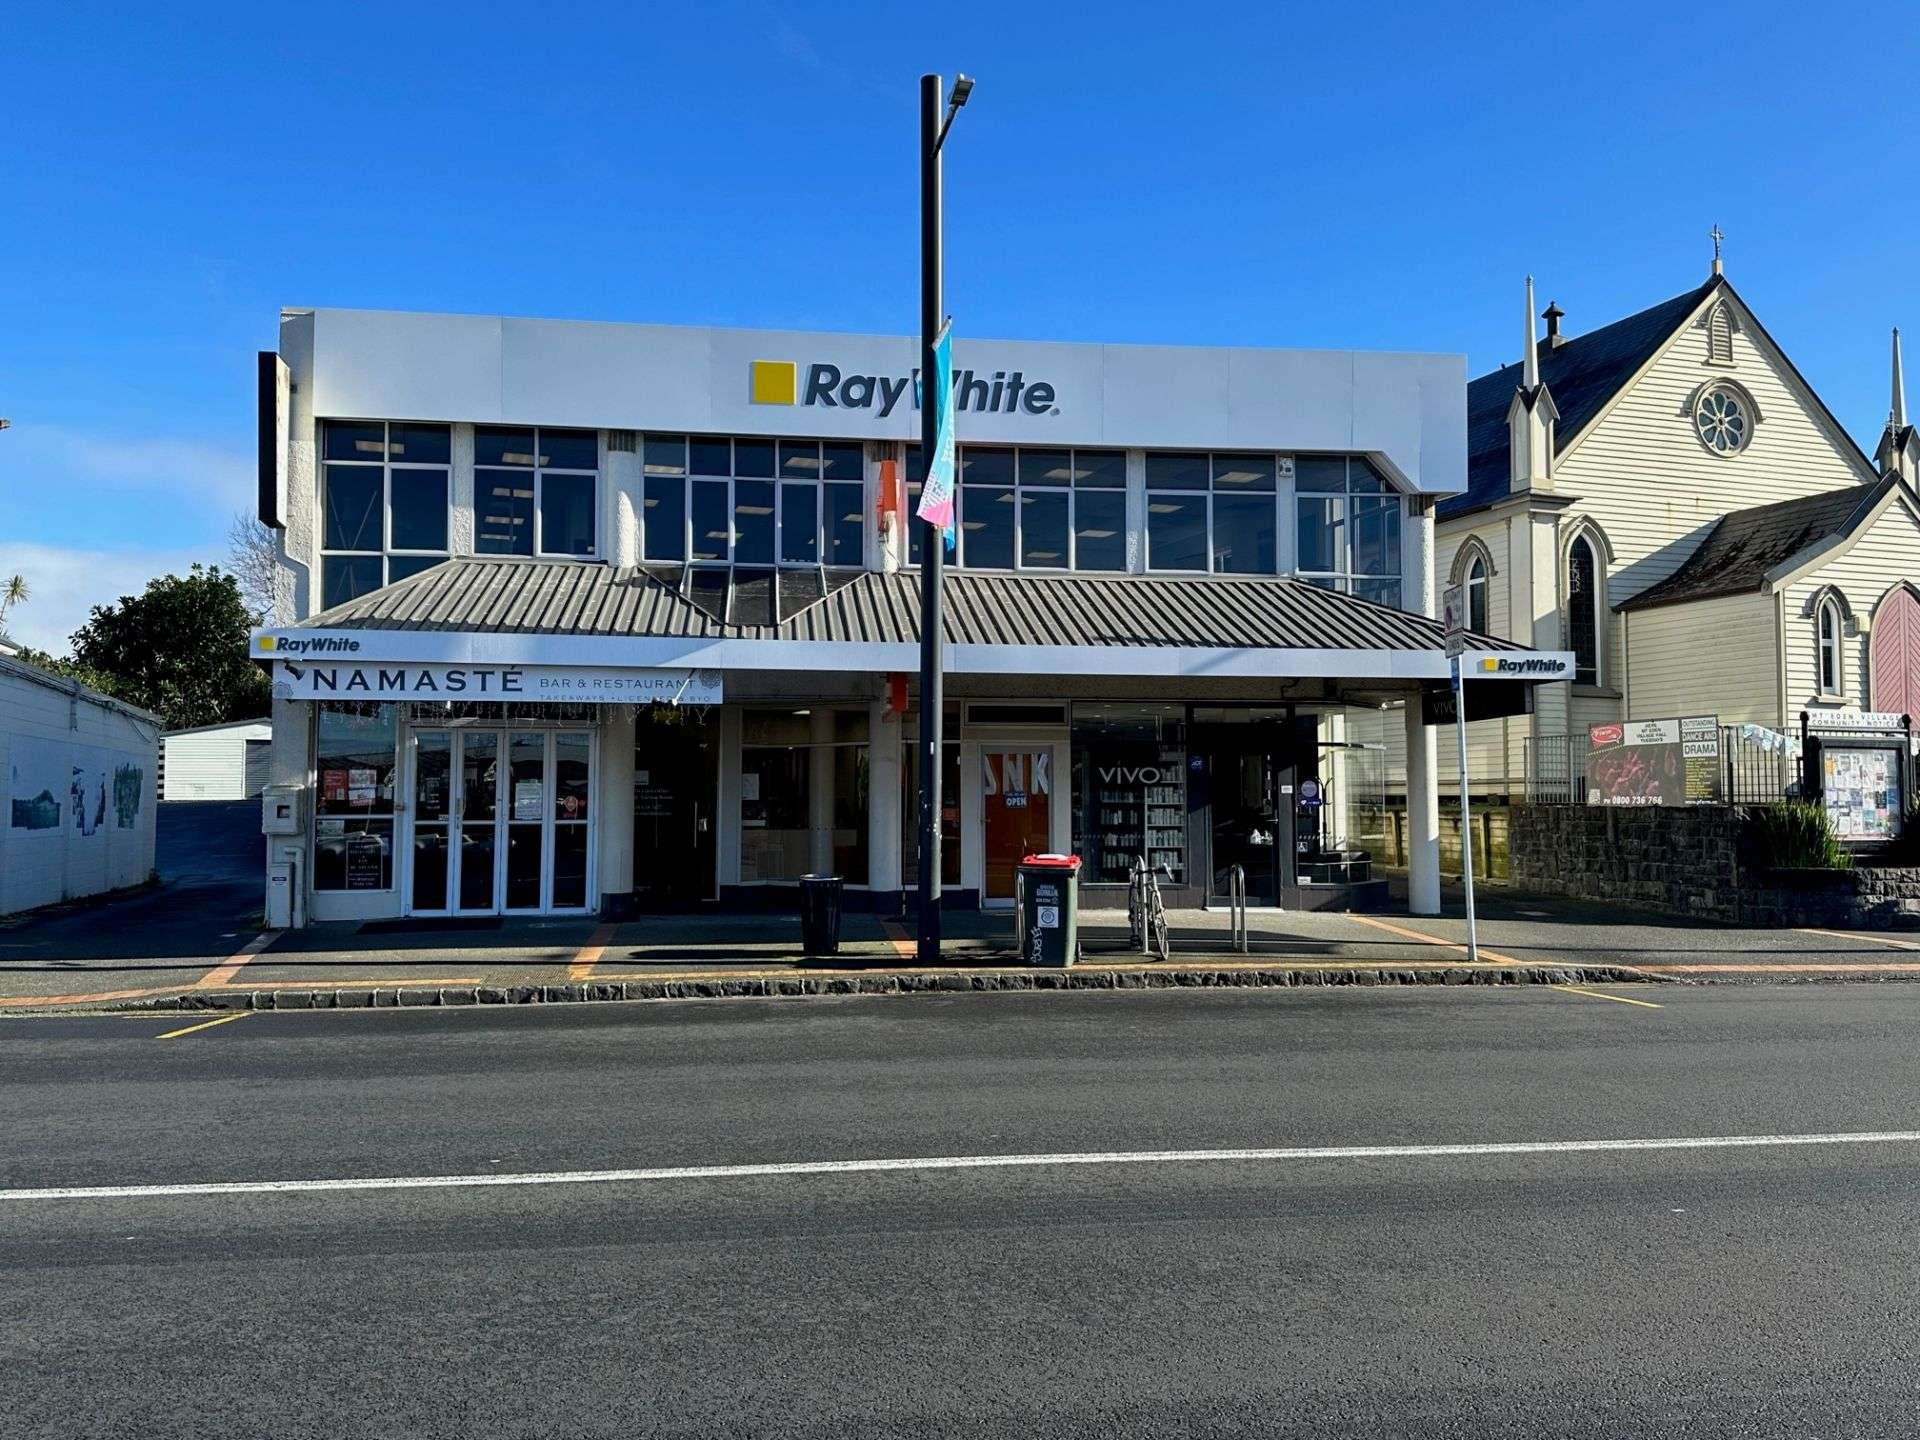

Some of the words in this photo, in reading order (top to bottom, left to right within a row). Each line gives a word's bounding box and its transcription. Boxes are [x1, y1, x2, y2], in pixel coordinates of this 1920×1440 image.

[277, 637, 360, 653] RayWhite
[1498, 658, 1566, 674] RayWhite
[313, 665, 522, 692] NAMASTÉ
[540, 678, 571, 688] BAR
[577, 678, 588, 688] &
[593, 679, 695, 689] RESTAURANT
[1682, 719, 1716, 727] OUTSTANDING
[1682, 732, 1703, 741] DANCE
[1704, 731, 1716, 740] AND
[1684, 744, 1716, 755] DRAMA
[1099, 761, 1160, 784] VIVO
[1006, 797, 1026, 806] OPEN
[1612, 796, 1630, 804] 0800
